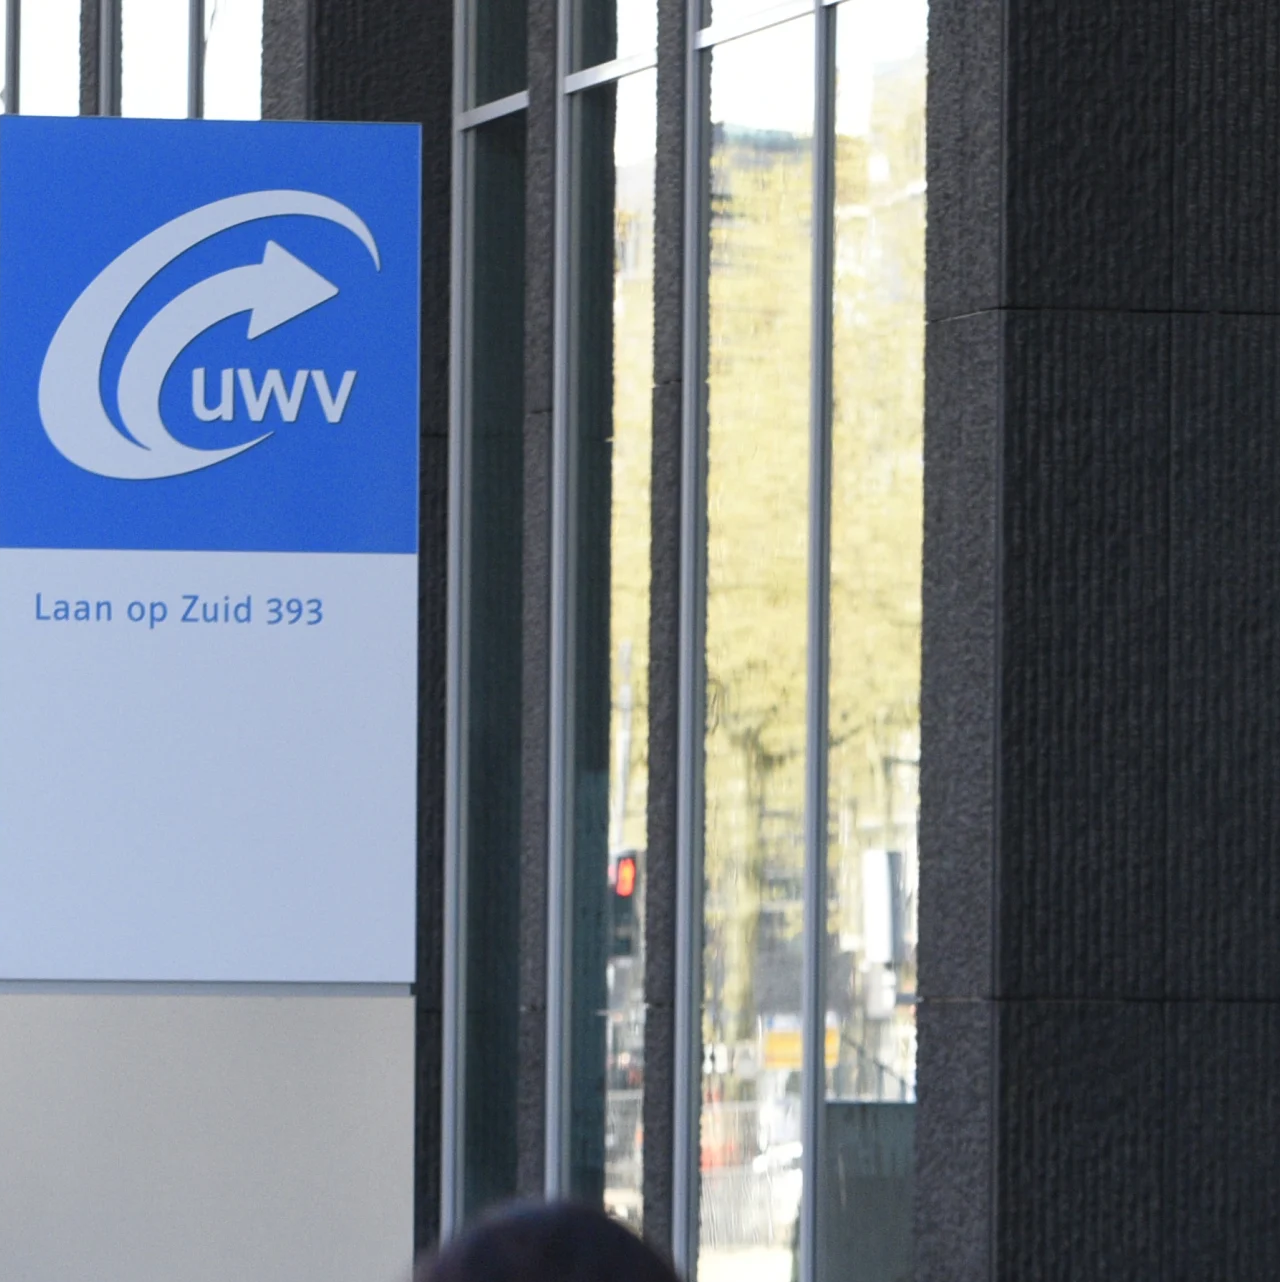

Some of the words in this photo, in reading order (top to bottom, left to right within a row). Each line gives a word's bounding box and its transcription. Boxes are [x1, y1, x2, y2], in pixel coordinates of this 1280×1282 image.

[35, 592, 114, 623] Laan
[126, 602, 169, 630] op
[181, 595, 253, 625] Zuid
[266, 598, 325, 626] 393
